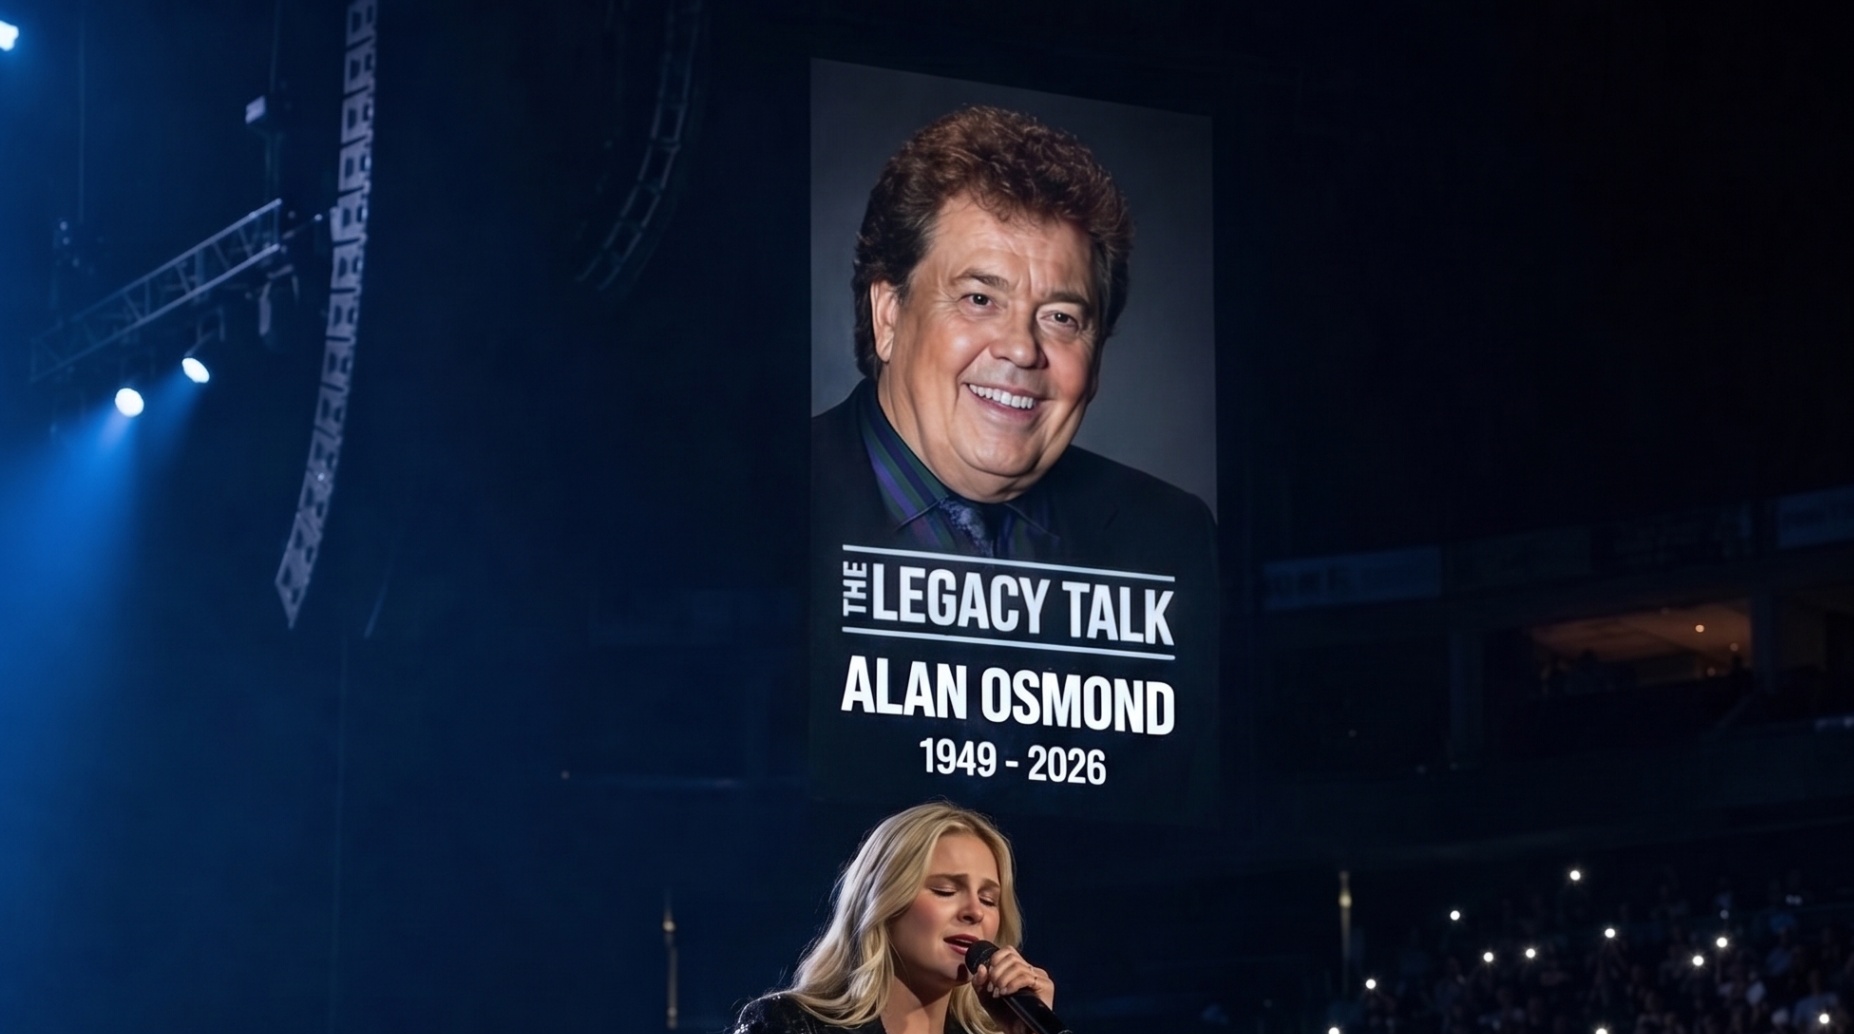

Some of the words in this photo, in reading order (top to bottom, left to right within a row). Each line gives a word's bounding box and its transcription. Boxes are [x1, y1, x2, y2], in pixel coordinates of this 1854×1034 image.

[843, 561, 867, 617] THE
[872, 563, 1051, 634] LEGACY
[1061, 580, 1175, 646] TALK
[841, 655, 967, 720] ALAN
[981, 667, 1175, 736] OSMOND
[919, 737, 997, 778] 1949
[1027, 744, 1107, 786] 2026
